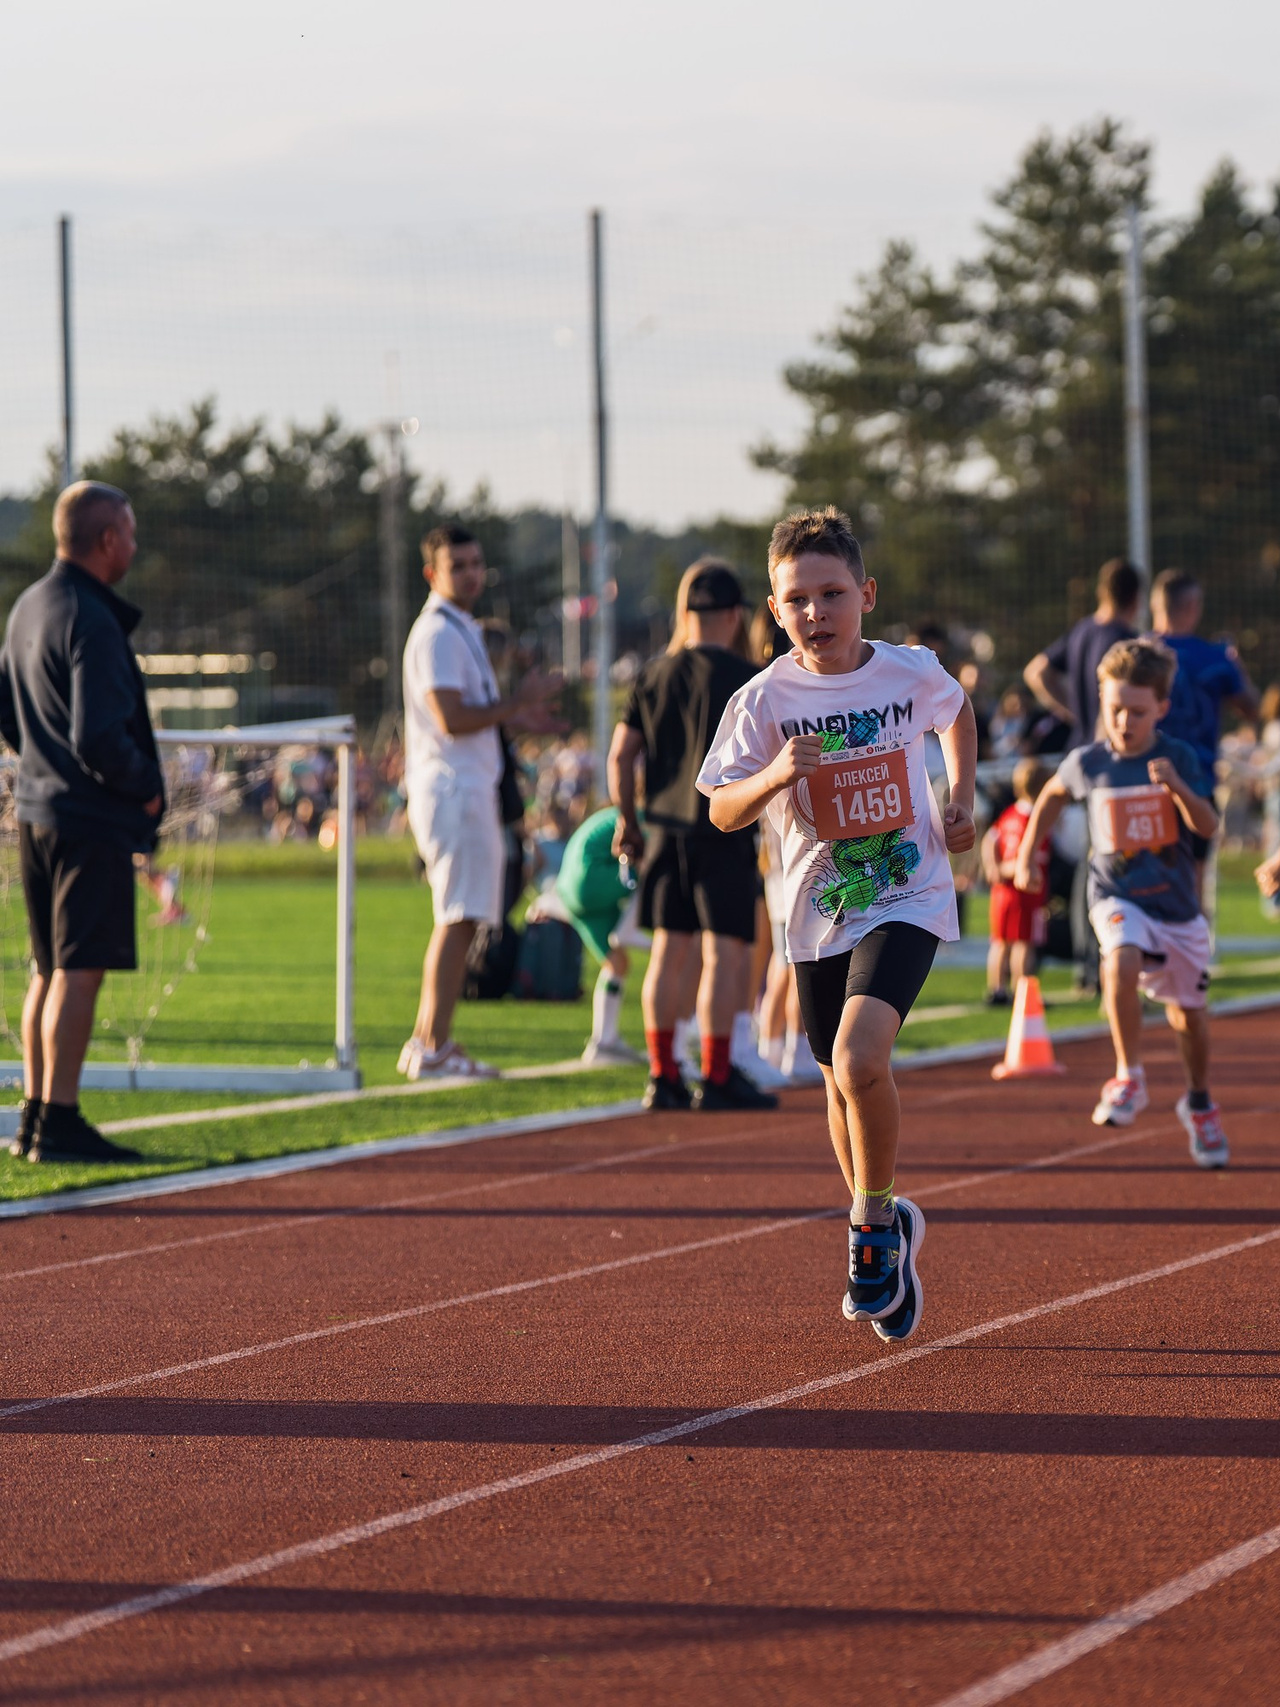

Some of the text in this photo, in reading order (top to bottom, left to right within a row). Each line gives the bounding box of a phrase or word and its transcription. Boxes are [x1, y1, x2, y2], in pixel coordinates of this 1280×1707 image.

[834, 762, 890, 789] АЛЕКСЕЙ
[831, 783, 902, 828] 1459
[1126, 814, 1166, 842] 491
